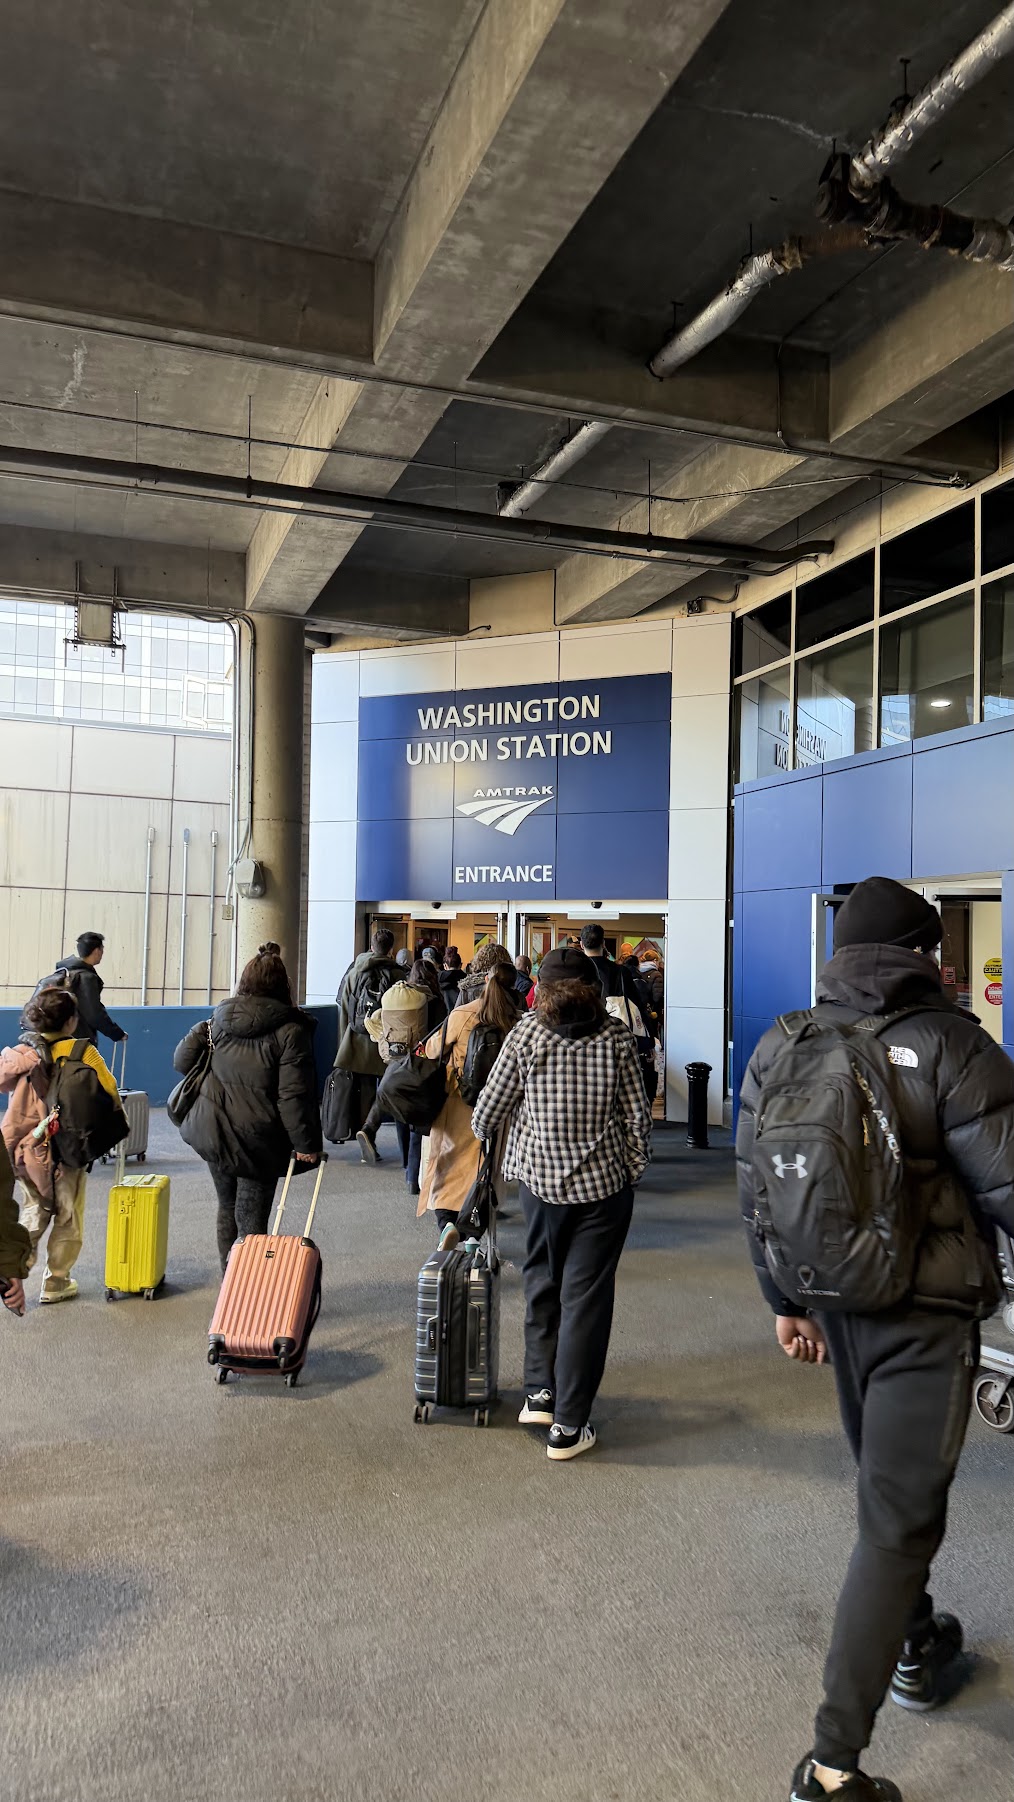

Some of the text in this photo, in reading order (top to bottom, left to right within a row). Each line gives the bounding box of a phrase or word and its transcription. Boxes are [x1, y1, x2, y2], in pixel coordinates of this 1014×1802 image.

[418, 694, 600, 731] WASHINGTON
[406, 730, 612, 766] UNION STATION
[473, 785, 554, 798] AMTRAK
[455, 865, 553, 884] ENTRANCE
[872, 1109, 900, 1164] ARMOU
